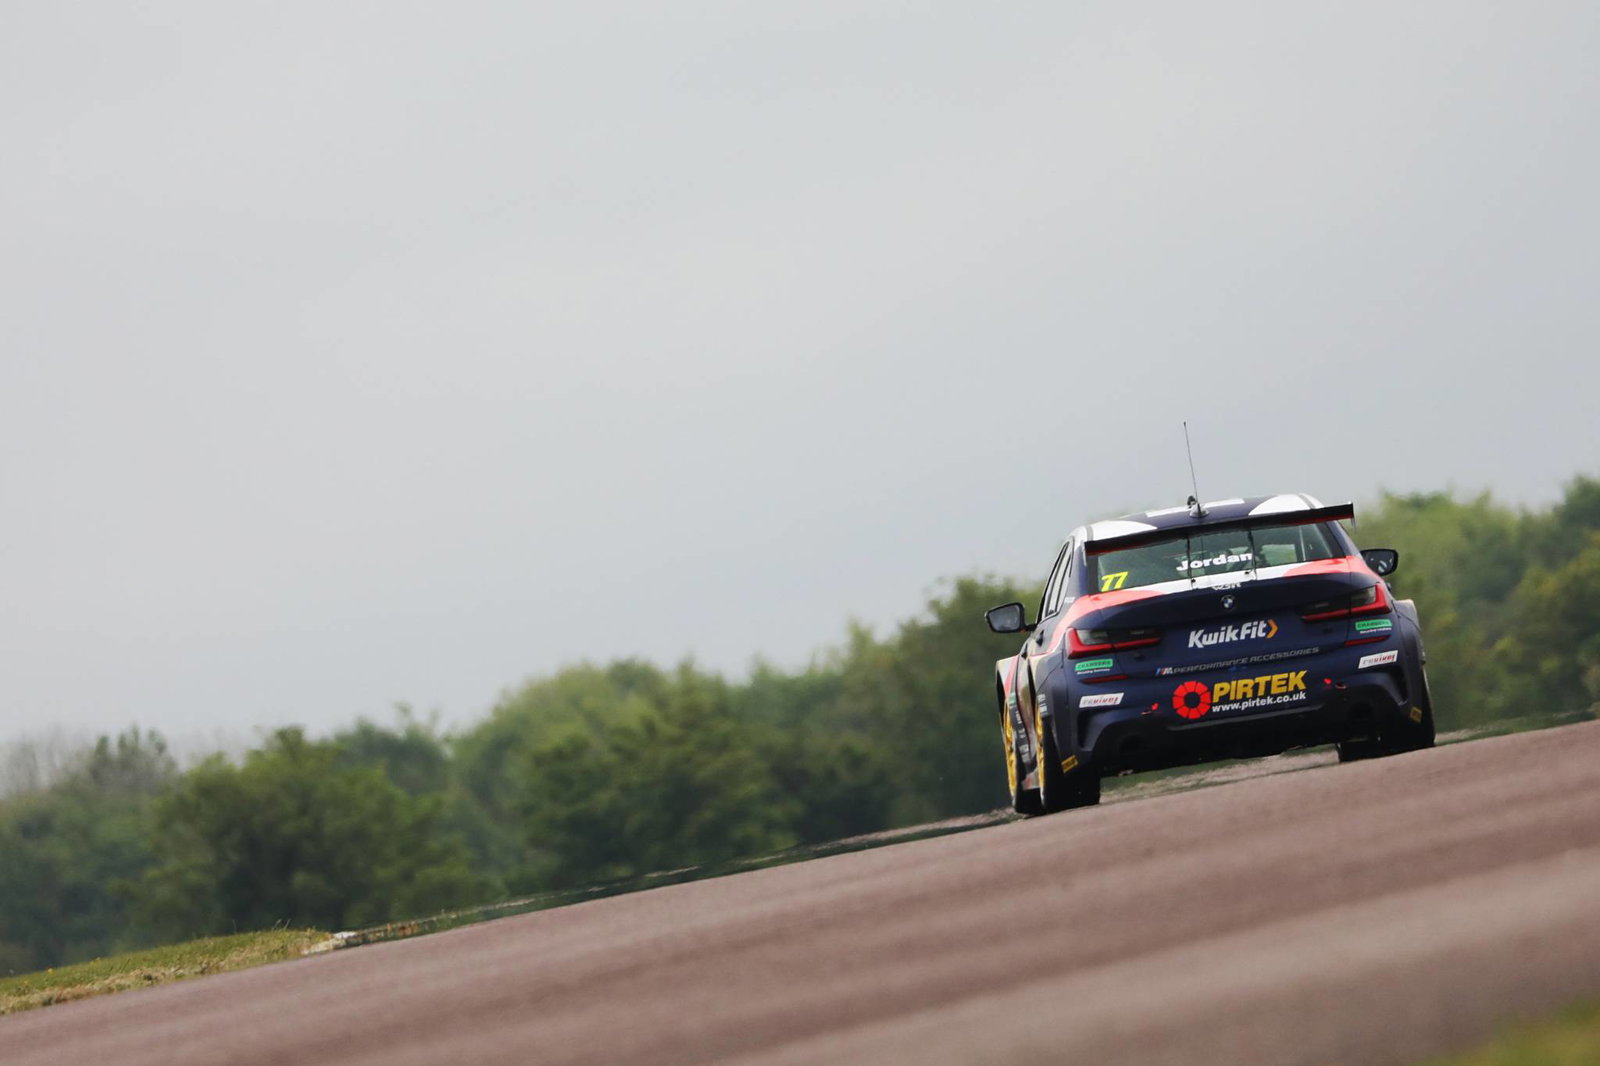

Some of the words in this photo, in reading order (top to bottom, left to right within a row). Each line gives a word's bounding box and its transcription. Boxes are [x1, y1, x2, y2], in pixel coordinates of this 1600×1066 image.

[1175, 552, 1253, 571] Jordan
[1101, 571, 1129, 592] 77
[1249, 646, 1319, 664] ACCESSORIES
[1212, 670, 1307, 703] PIRTEK
[1211, 691, 1307, 713] www.pirtek.co.uk
